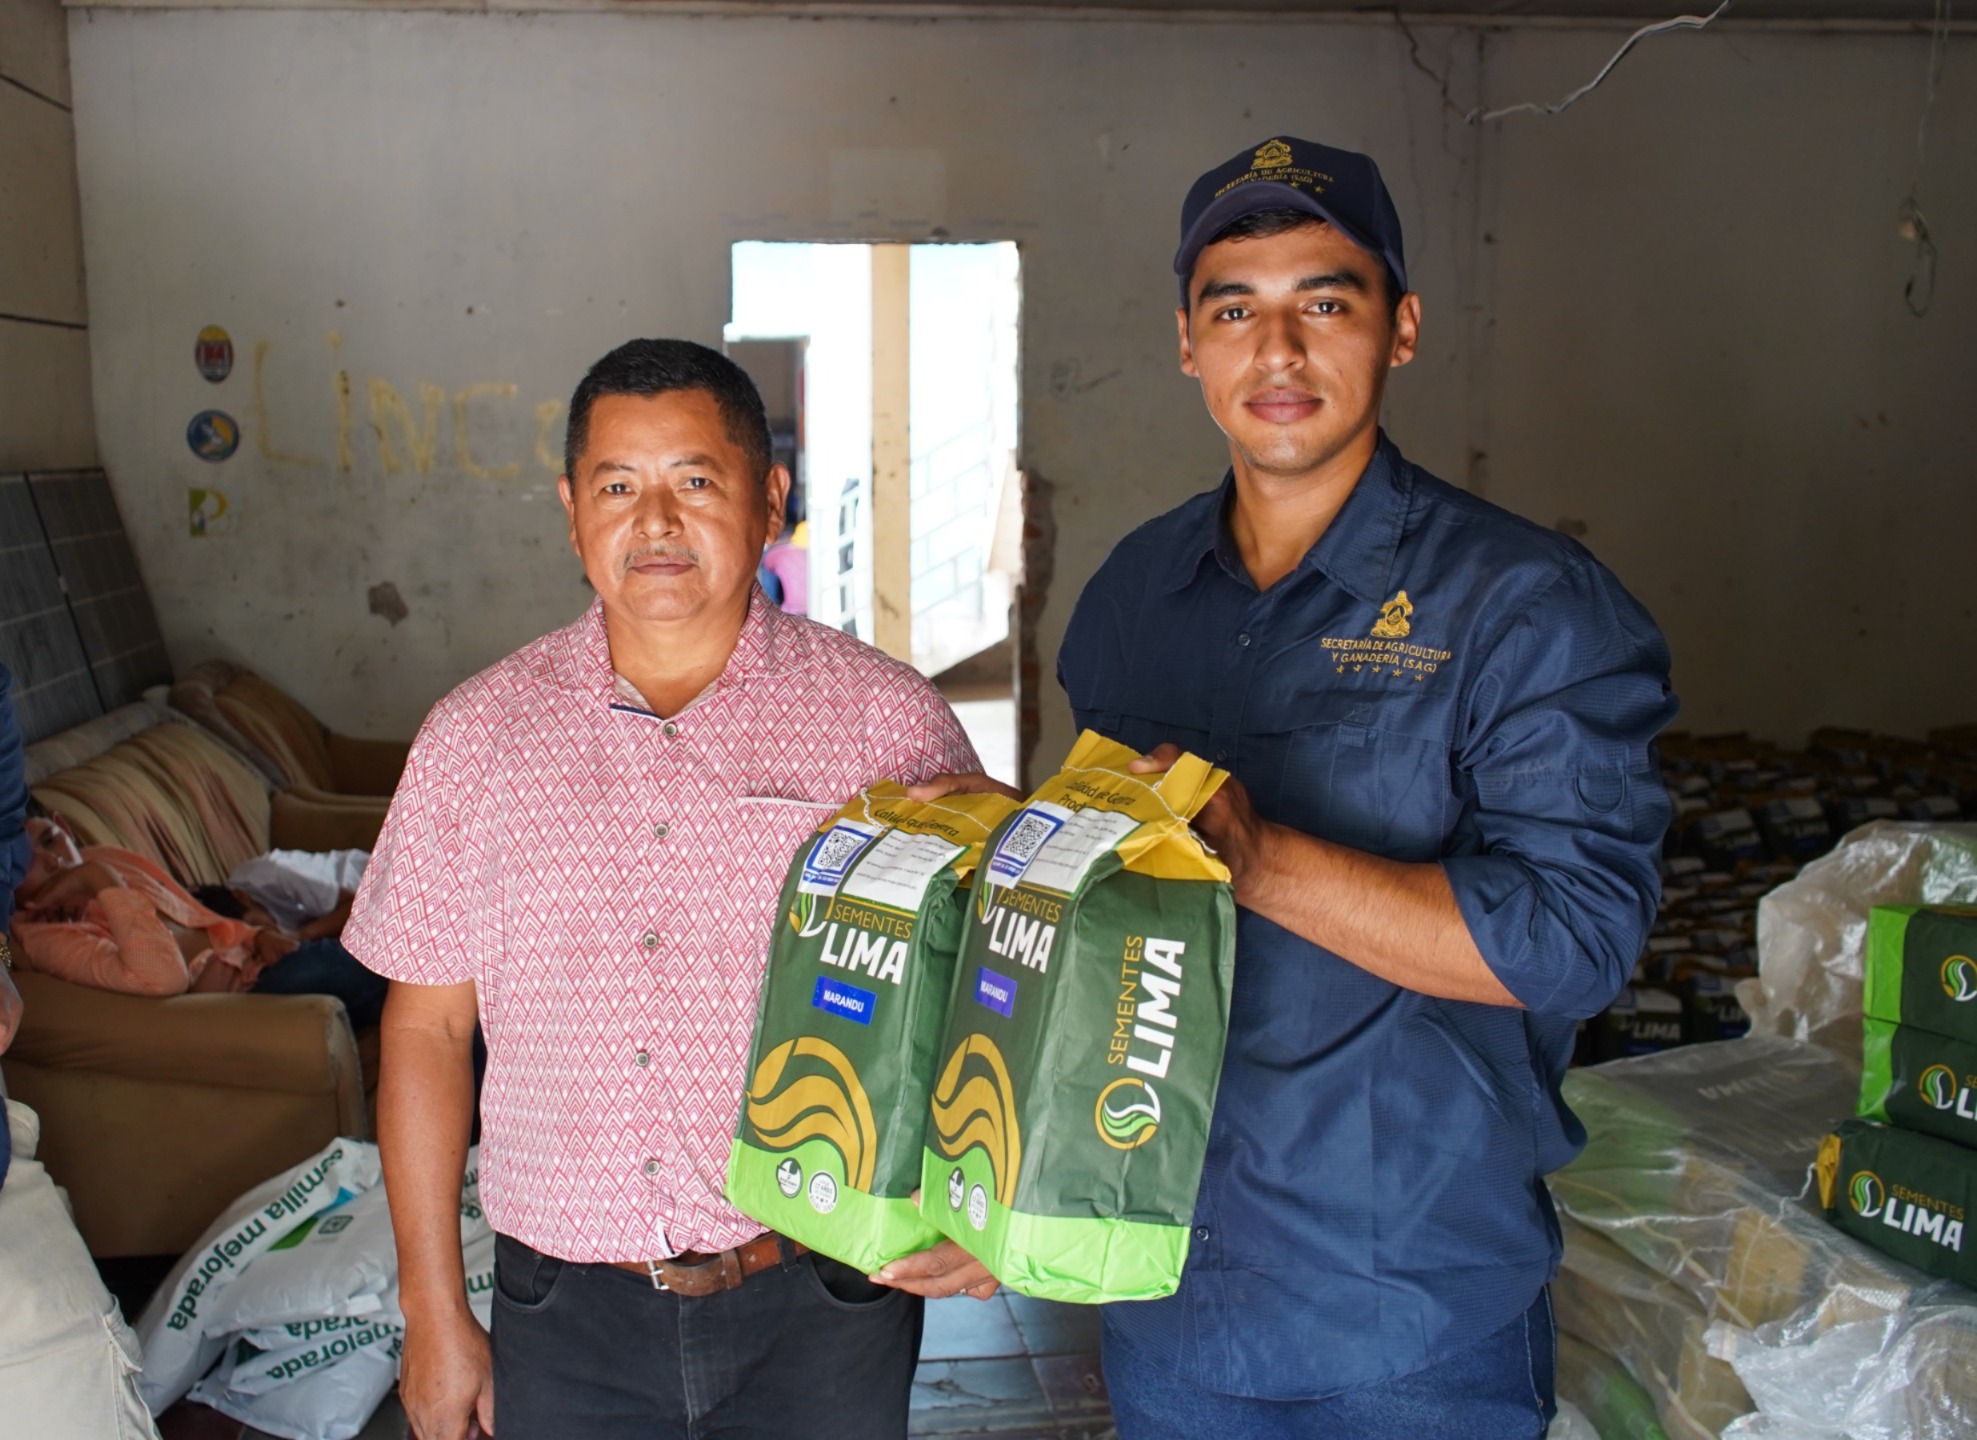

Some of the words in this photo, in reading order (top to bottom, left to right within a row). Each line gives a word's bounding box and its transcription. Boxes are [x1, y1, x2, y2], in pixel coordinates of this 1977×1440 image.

[1321, 637, 1371, 650] SECRETARÍA
[1372, 640, 1384, 651] DE
[1385, 641, 1453, 661] AGRICULTURA
[1332, 652, 1339, 662] Y
[1341, 652, 1400, 665] GANADERÍA
[1403, 658, 1438, 674] (SAG)
[834, 904, 914, 940] SEMENTES
[1004, 890, 1063, 923] SEMENTES
[820, 922, 909, 985] LIMA
[989, 907, 1056, 974] LIMA
[823, 989, 865, 1013] MARANDU
[980, 980, 1008, 1003] MARANDU
[1107, 935, 1143, 1065] SEMENTES
[1126, 937, 1186, 1079] LIMA
[1632, 1020, 1682, 1042] LIMA
[1892, 1183, 1965, 1221] SEMENTES
[1883, 1197, 1964, 1253] LIMA
[166, 1218, 267, 1331] mejorada
